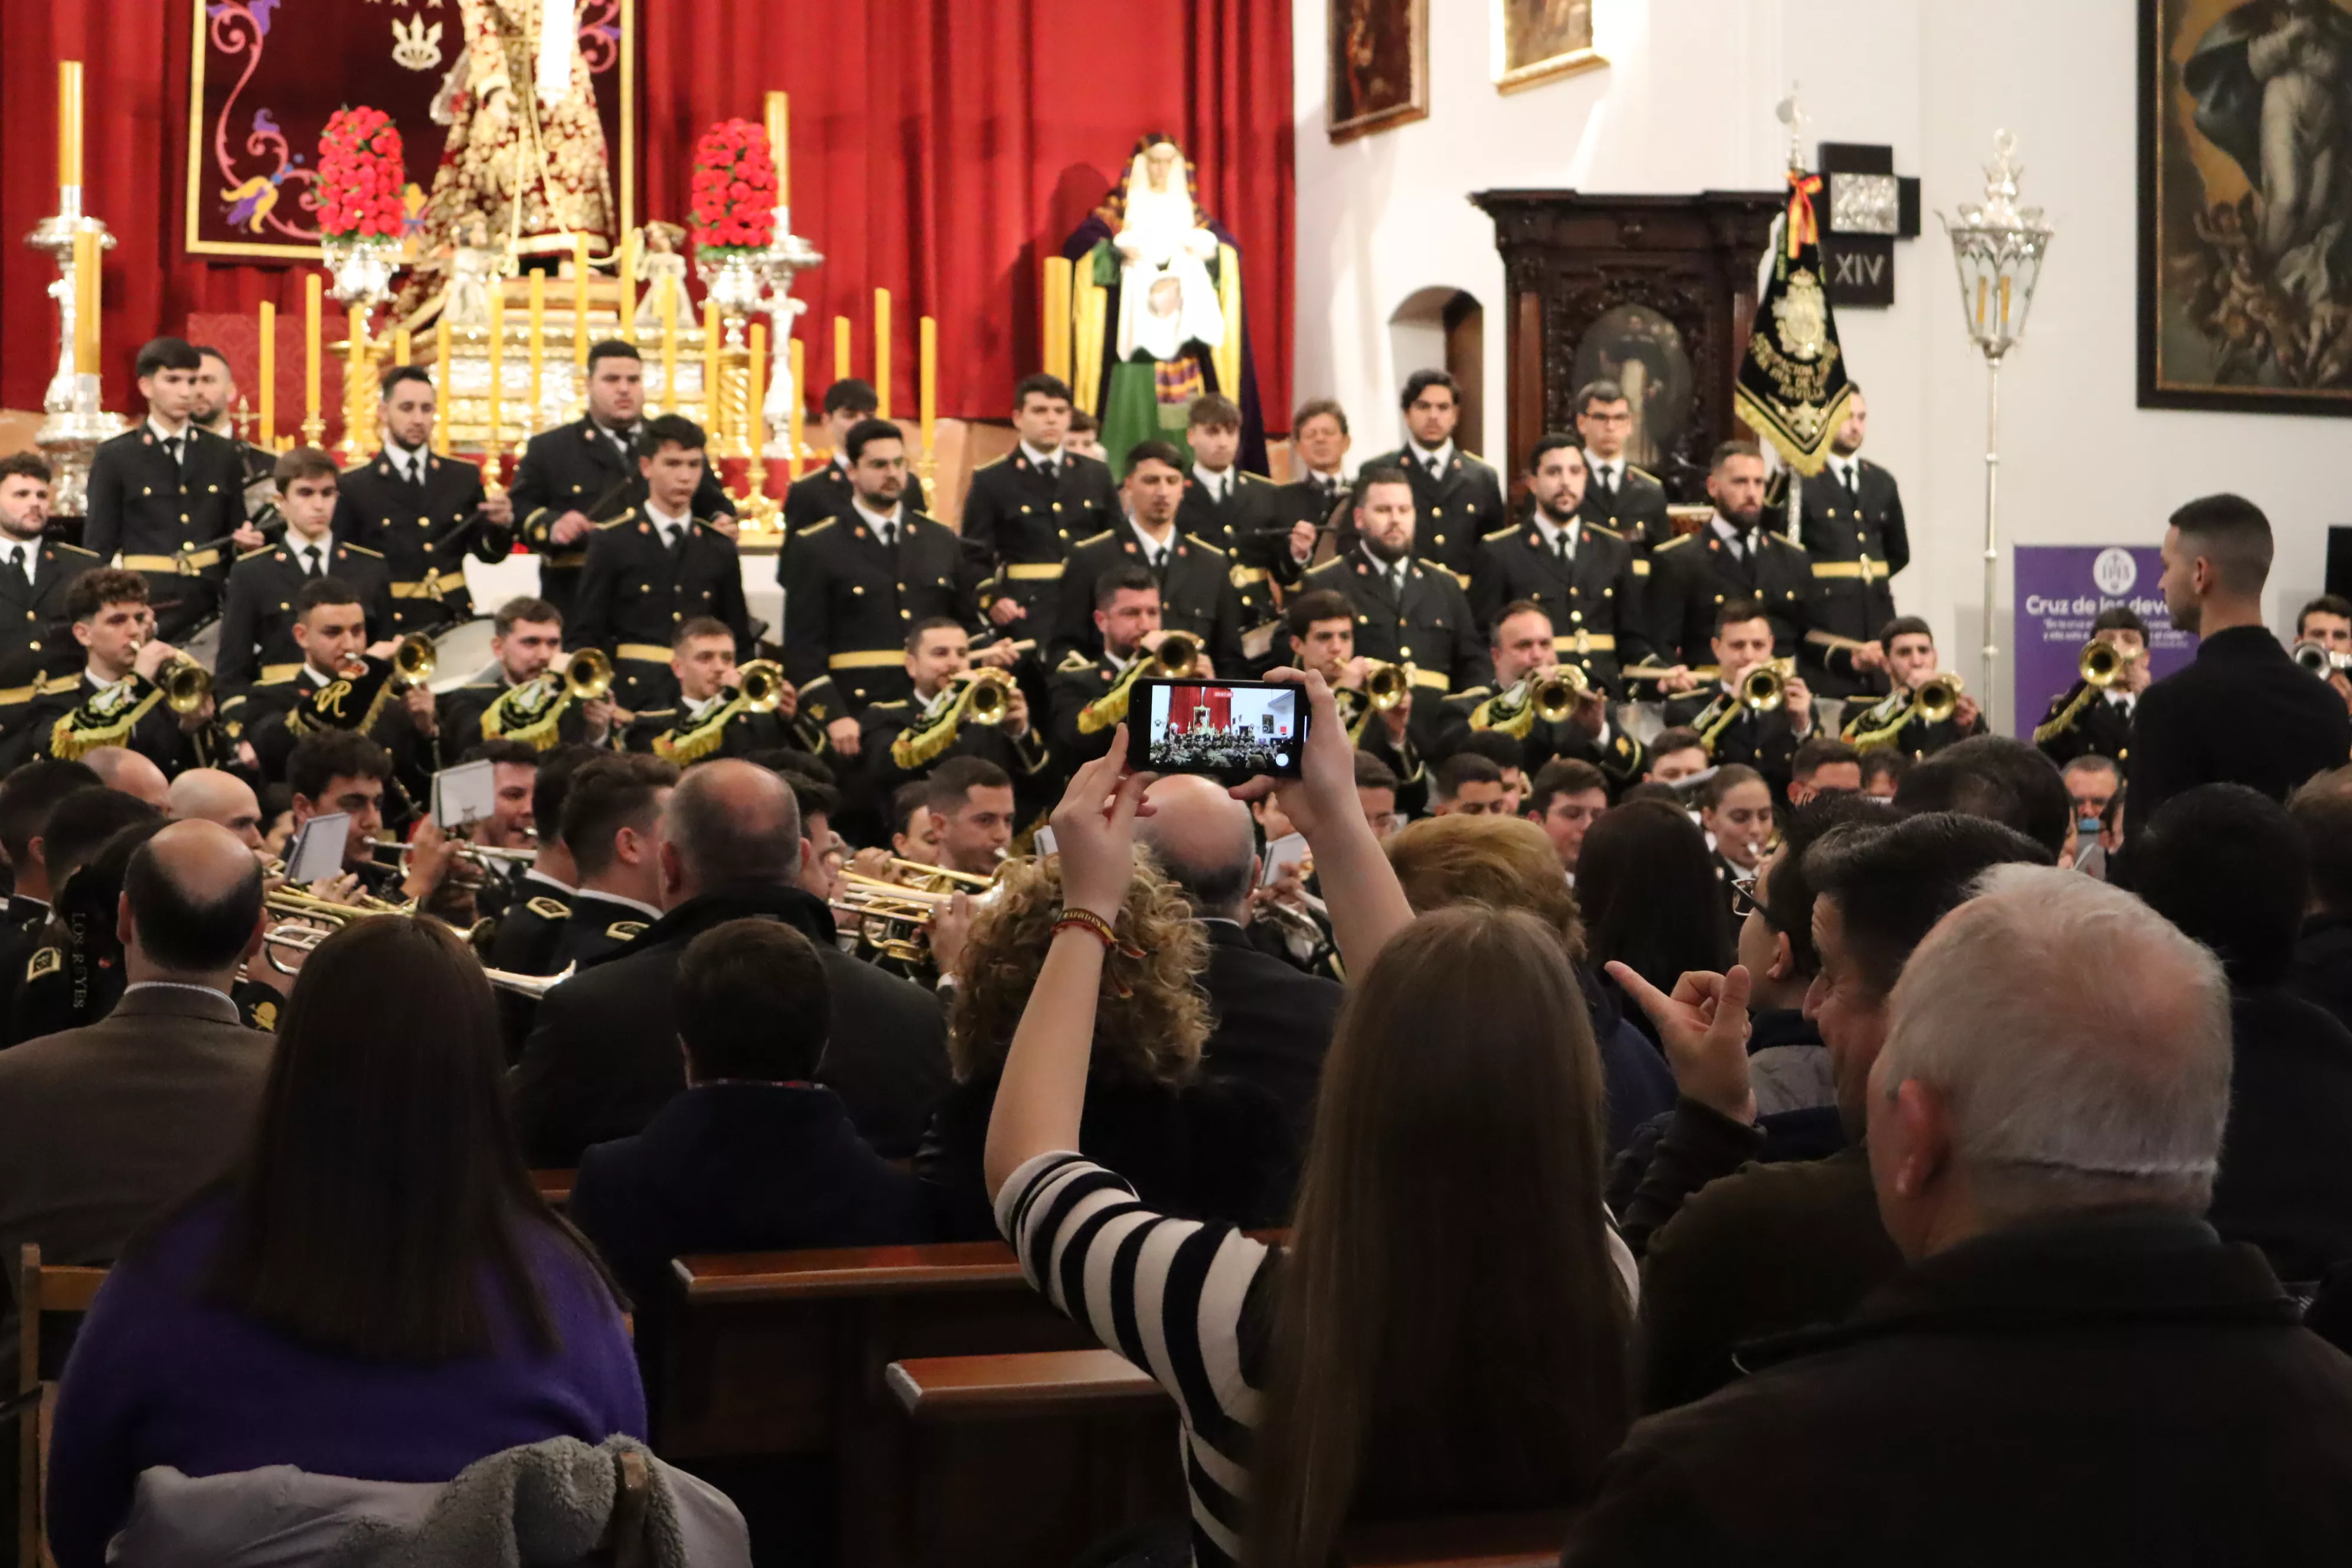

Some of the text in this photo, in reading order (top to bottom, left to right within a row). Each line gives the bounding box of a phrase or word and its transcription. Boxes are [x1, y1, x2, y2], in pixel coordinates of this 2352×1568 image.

[1834, 253, 1885, 286] XIV
[2026, 594, 2069, 615] Cruz
[2072, 595, 2096, 615] de
[72, 912, 88, 1008] LOS REYES
